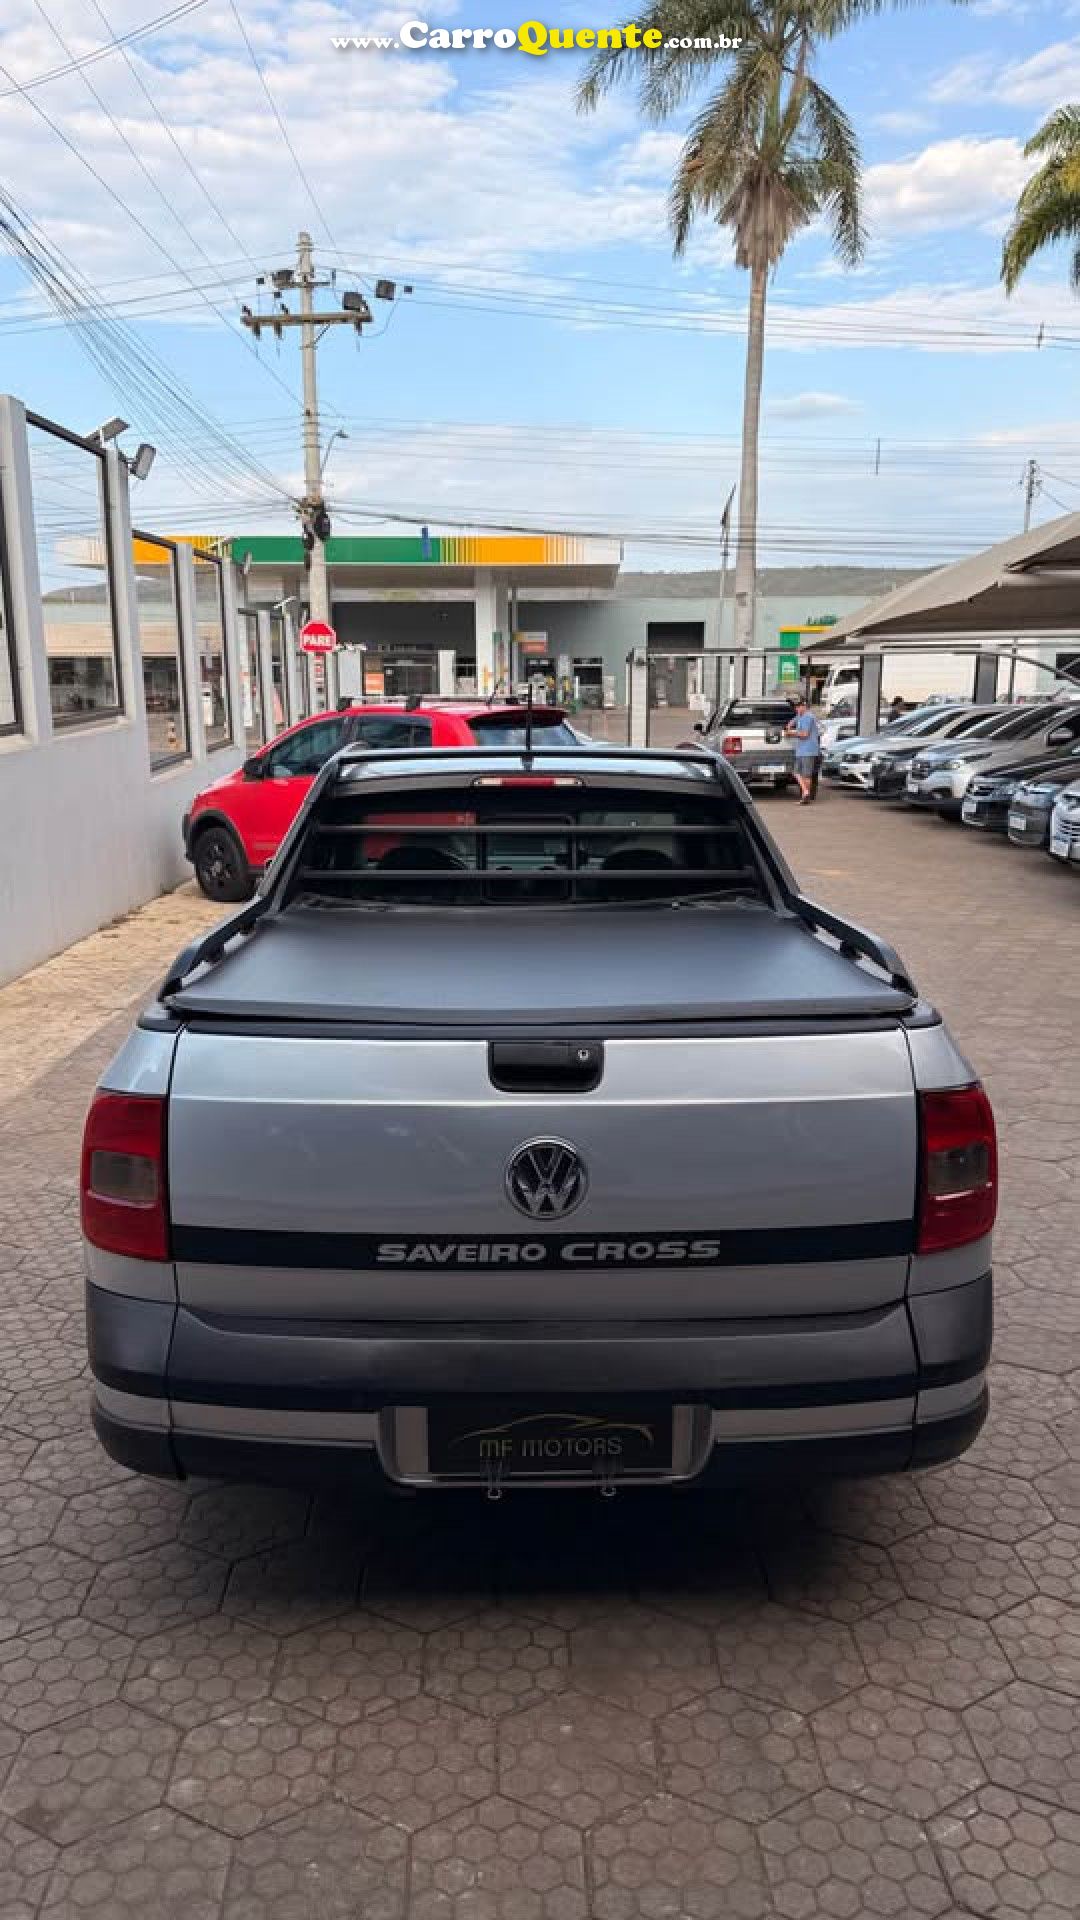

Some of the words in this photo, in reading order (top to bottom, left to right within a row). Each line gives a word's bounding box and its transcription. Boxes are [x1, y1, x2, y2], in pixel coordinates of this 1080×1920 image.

[303, 633, 331, 647] PARE
[376, 1243, 547, 1263] SAVEIRO
[561, 1240, 721, 1261] CROSS
[479, 1439, 513, 1457] MF
[521, 1437, 622, 1457] MOTORS
